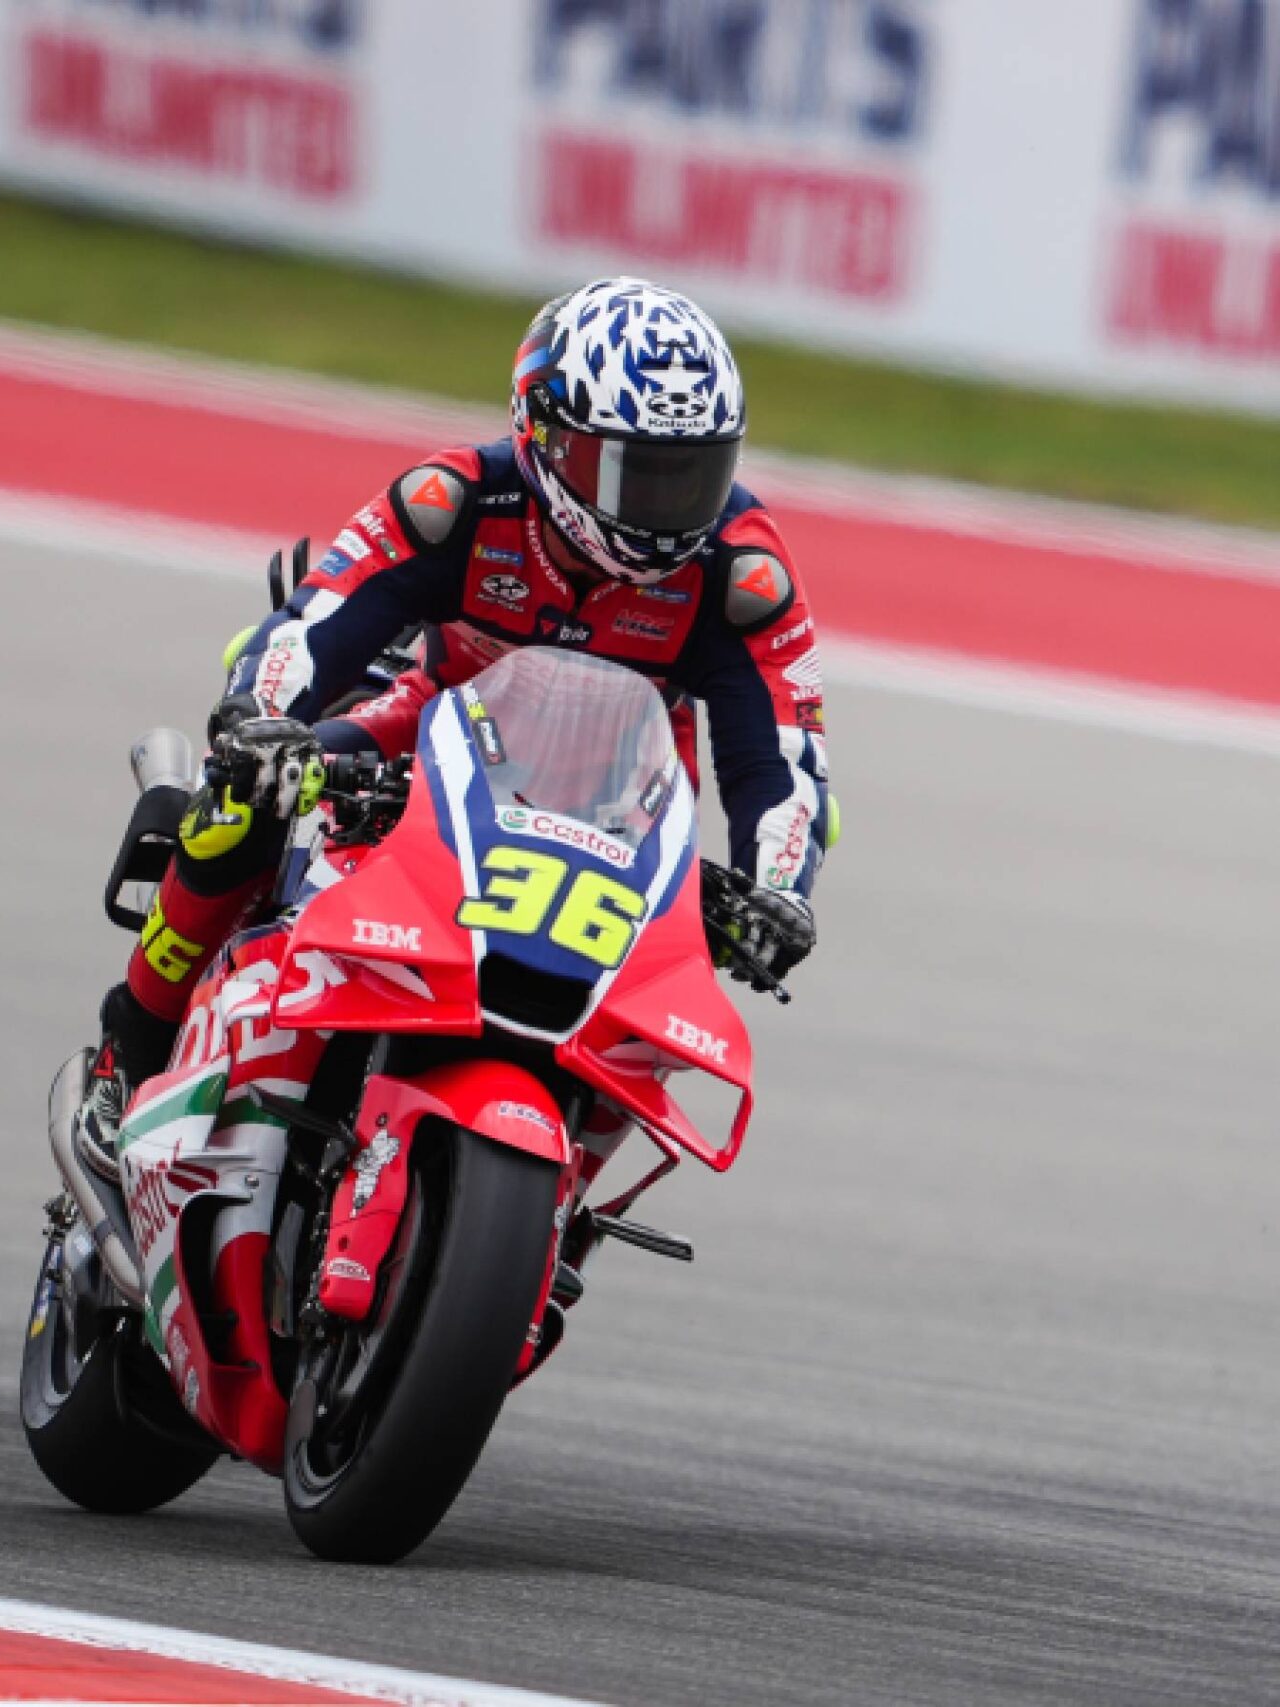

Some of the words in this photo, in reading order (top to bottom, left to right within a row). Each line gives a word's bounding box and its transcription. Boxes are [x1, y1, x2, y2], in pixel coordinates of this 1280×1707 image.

[532, 814, 631, 866] Castrol
[458, 846, 646, 967] 36
[352, 918, 422, 951] IBM
[665, 1014, 731, 1065] IBM
